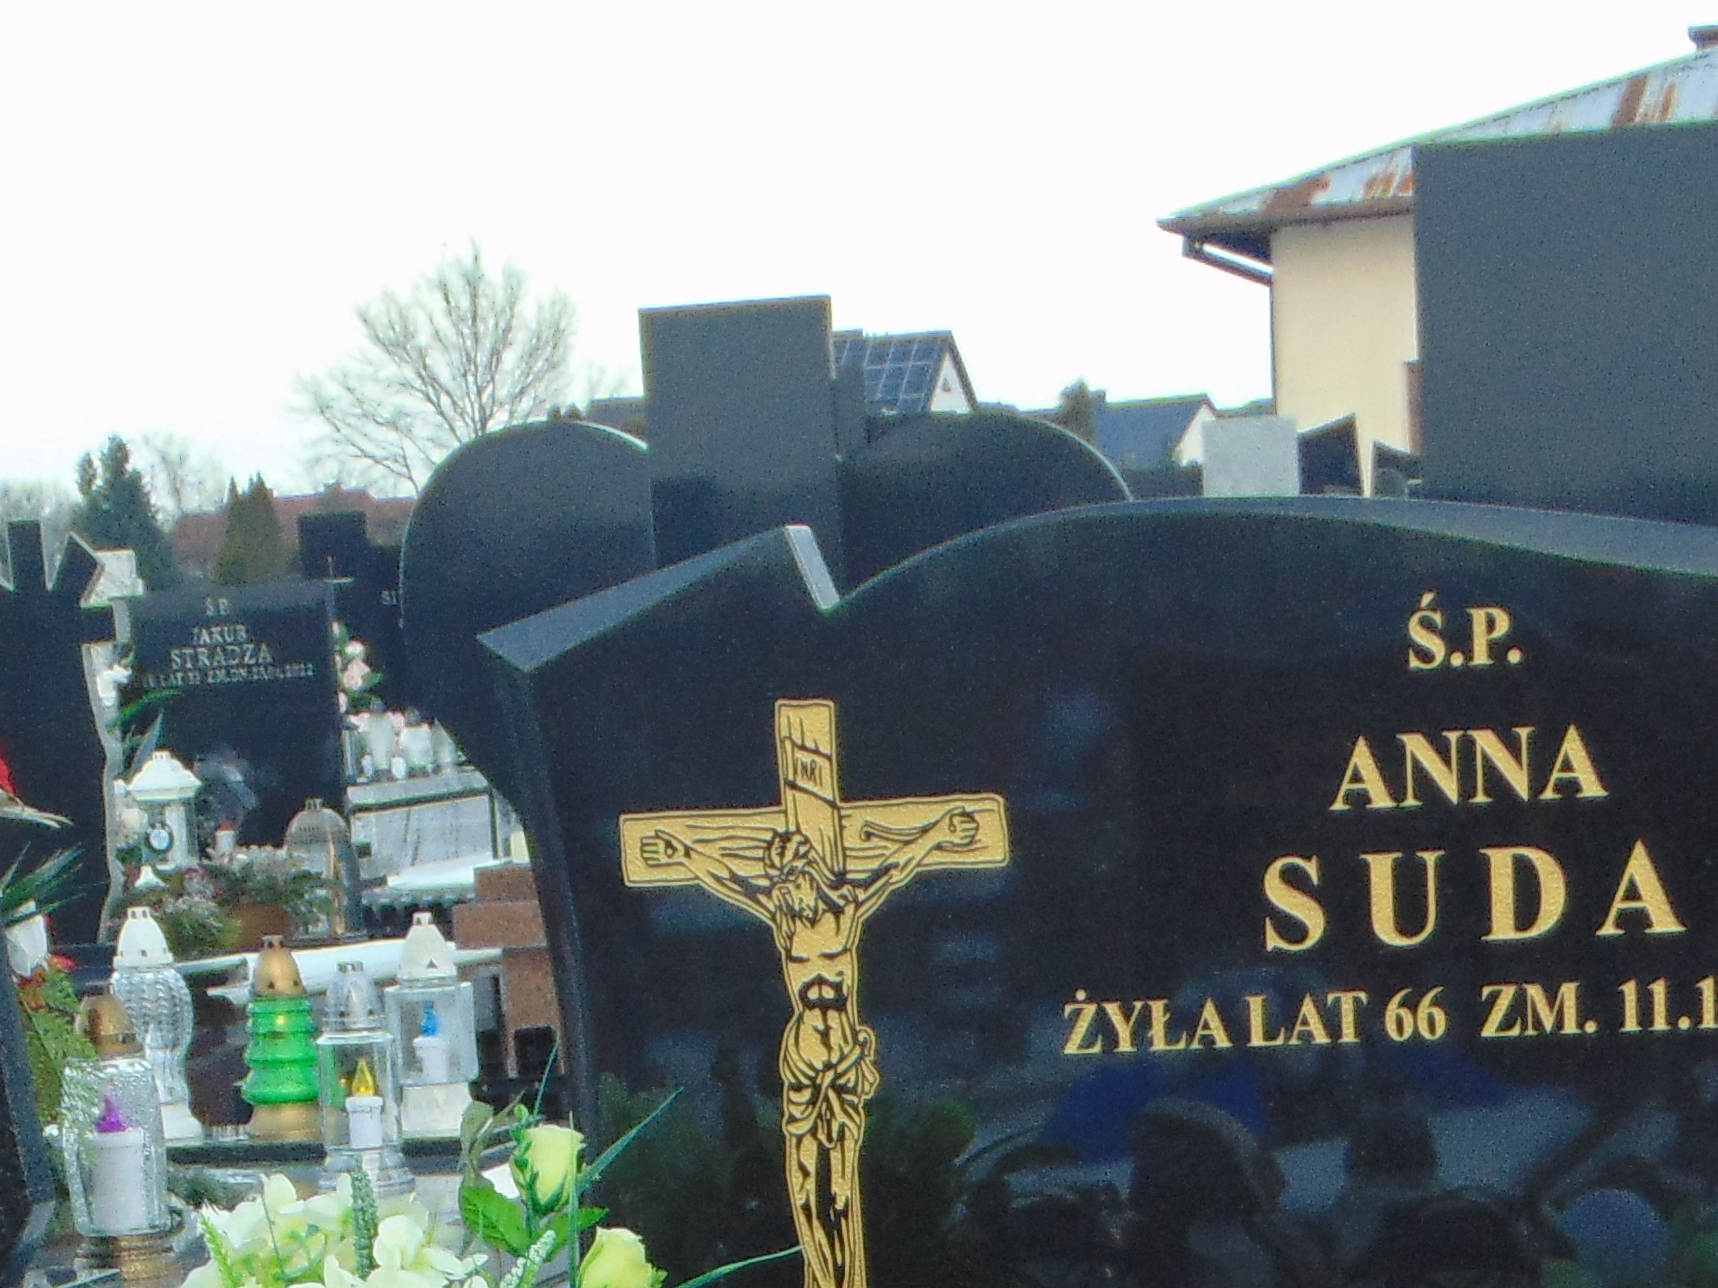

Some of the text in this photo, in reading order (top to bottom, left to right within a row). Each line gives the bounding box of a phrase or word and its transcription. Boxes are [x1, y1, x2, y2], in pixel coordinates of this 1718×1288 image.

[169, 643, 274, 669] STRADZA
[1407, 591, 1523, 671] Ś.P.
[1329, 724, 1608, 812] ANNA
[1262, 839, 1687, 953] SUDA
[1062, 989, 1235, 1056] ŻYŁA
[1246, 991, 1367, 1048] LAT
[1384, 986, 1449, 1043] 66
[1480, 982, 1599, 1039] ZM.
